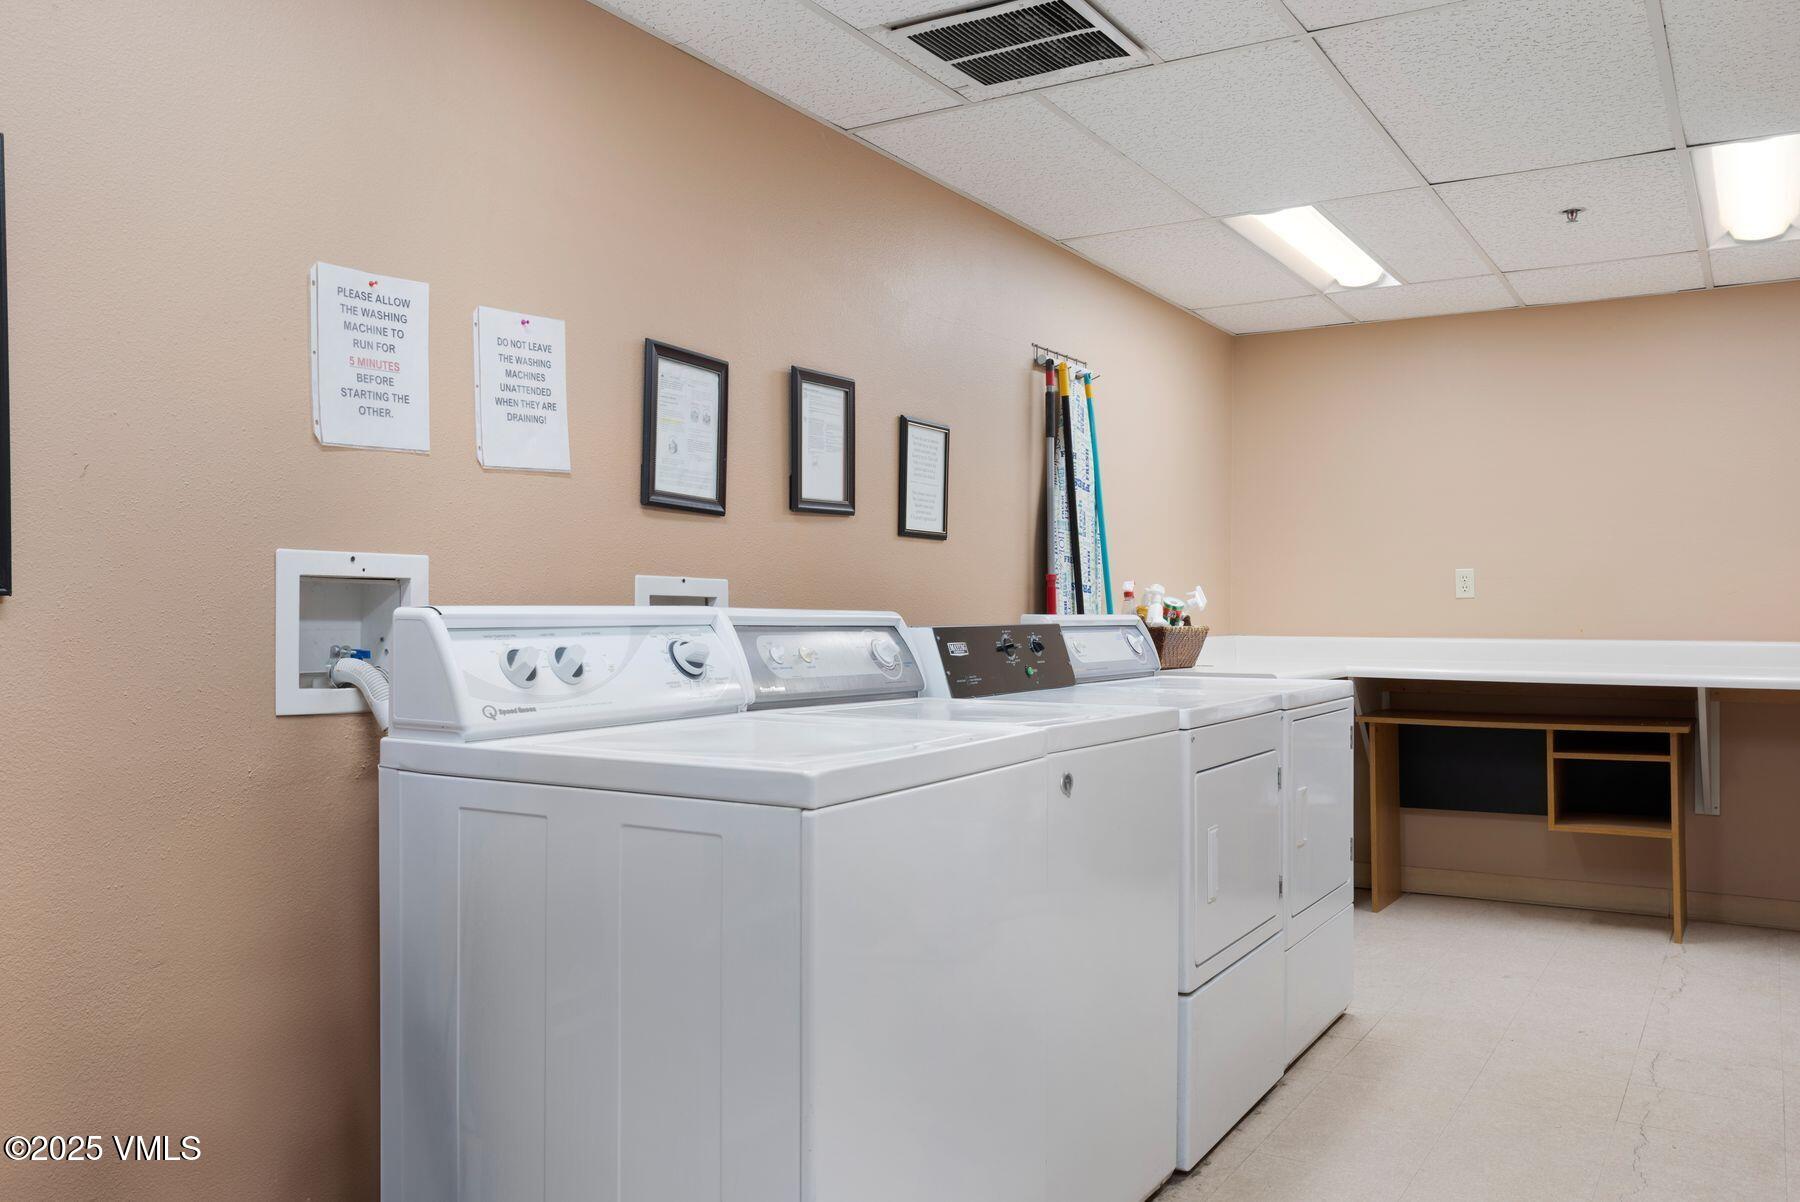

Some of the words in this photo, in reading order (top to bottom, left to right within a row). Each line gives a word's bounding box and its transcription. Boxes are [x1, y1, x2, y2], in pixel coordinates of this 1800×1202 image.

[338, 287, 372, 302] PLEASE
[375, 294, 410, 308] ALLOW
[340, 304, 358, 316] THE
[361, 308, 407, 323] WASHING
[344, 320, 388, 336] MACHINE
[391, 328, 404, 339] TO
[353, 339, 374, 350] RUN
[376, 342, 395, 353] FOR
[497, 337, 508, 347] DO
[511, 339, 526, 349] NOT
[529, 342, 552, 353] LEAVE
[349, 356, 355, 367] 5
[357, 357, 400, 371] MINUTES
[498, 354, 513, 364] THE
[515, 356, 551, 369] WASHING
[357, 373, 394, 386] BEFORE
[505, 369, 545, 382] MACHINES
[341, 387, 389, 401] STARTING
[392, 393, 410, 404] THE
[500, 383, 551, 396] UNATTENDED
[495, 397, 518, 407] WHEN
[521, 400, 540, 410] THEY
[542, 402, 556, 411] ARE
[359, 406, 393, 418] OTHER.
[507, 413, 546, 424] DRAINING!
